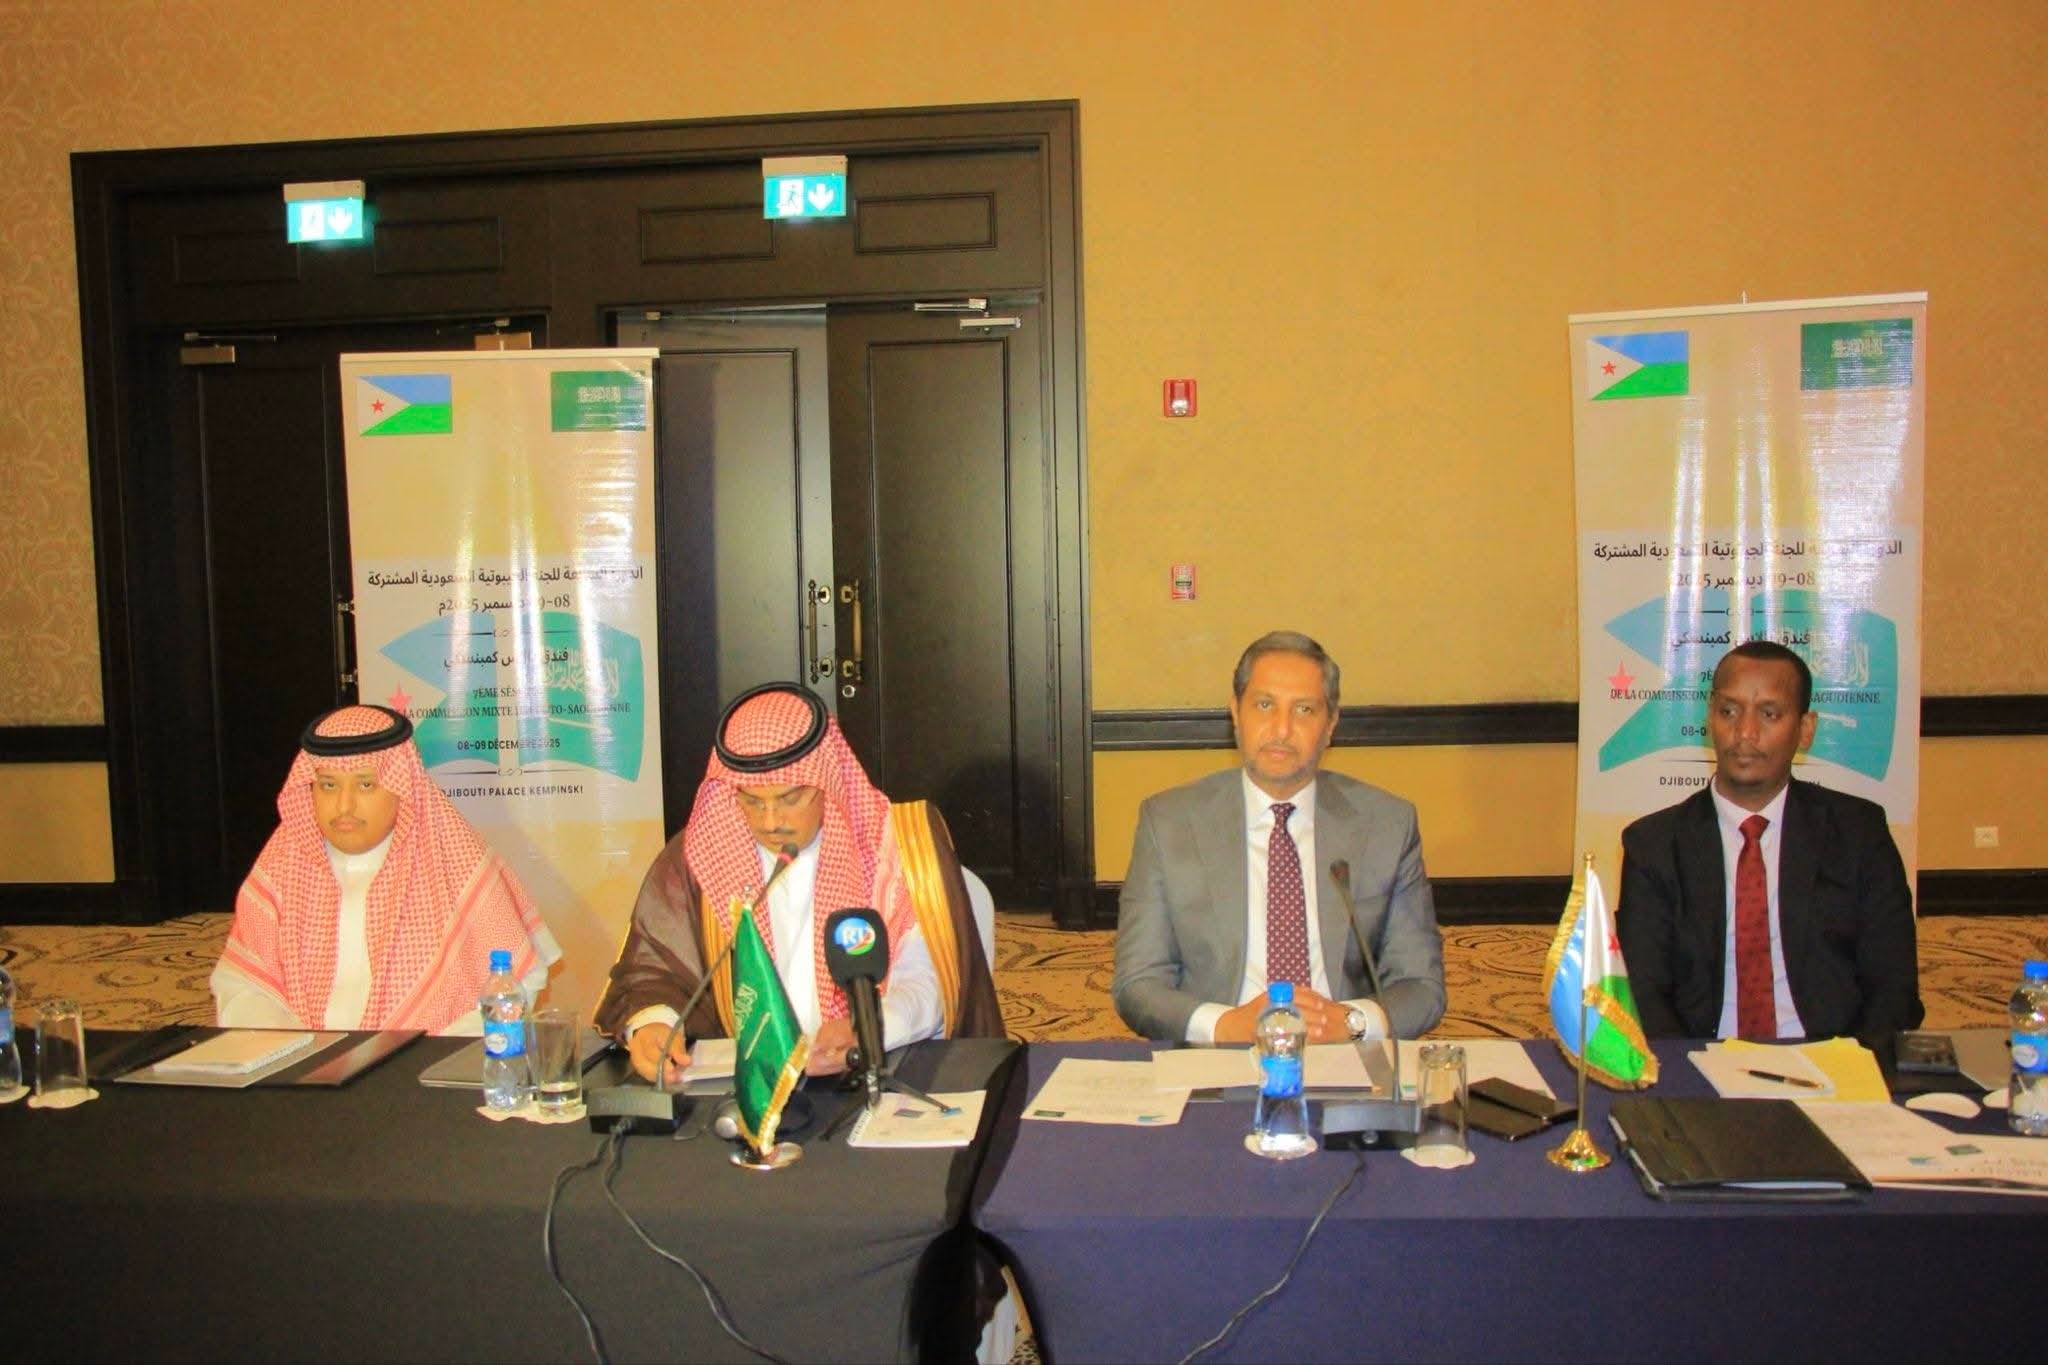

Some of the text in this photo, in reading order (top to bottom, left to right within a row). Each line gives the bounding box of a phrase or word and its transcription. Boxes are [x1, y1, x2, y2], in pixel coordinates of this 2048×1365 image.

[1594, 543, 1646, 560] المشتركة
[368, 571, 418, 589] المشتركة
[1610, 688, 1622, 699] DE
[1625, 689, 1636, 700] LA
[483, 706, 513, 717] MIXTE
[1681, 726, 1707, 736] 08-0
[457, 740, 486, 751] 08-09
[489, 787, 527, 796] PALACE
[530, 785, 584, 795] KEMPINSKI
